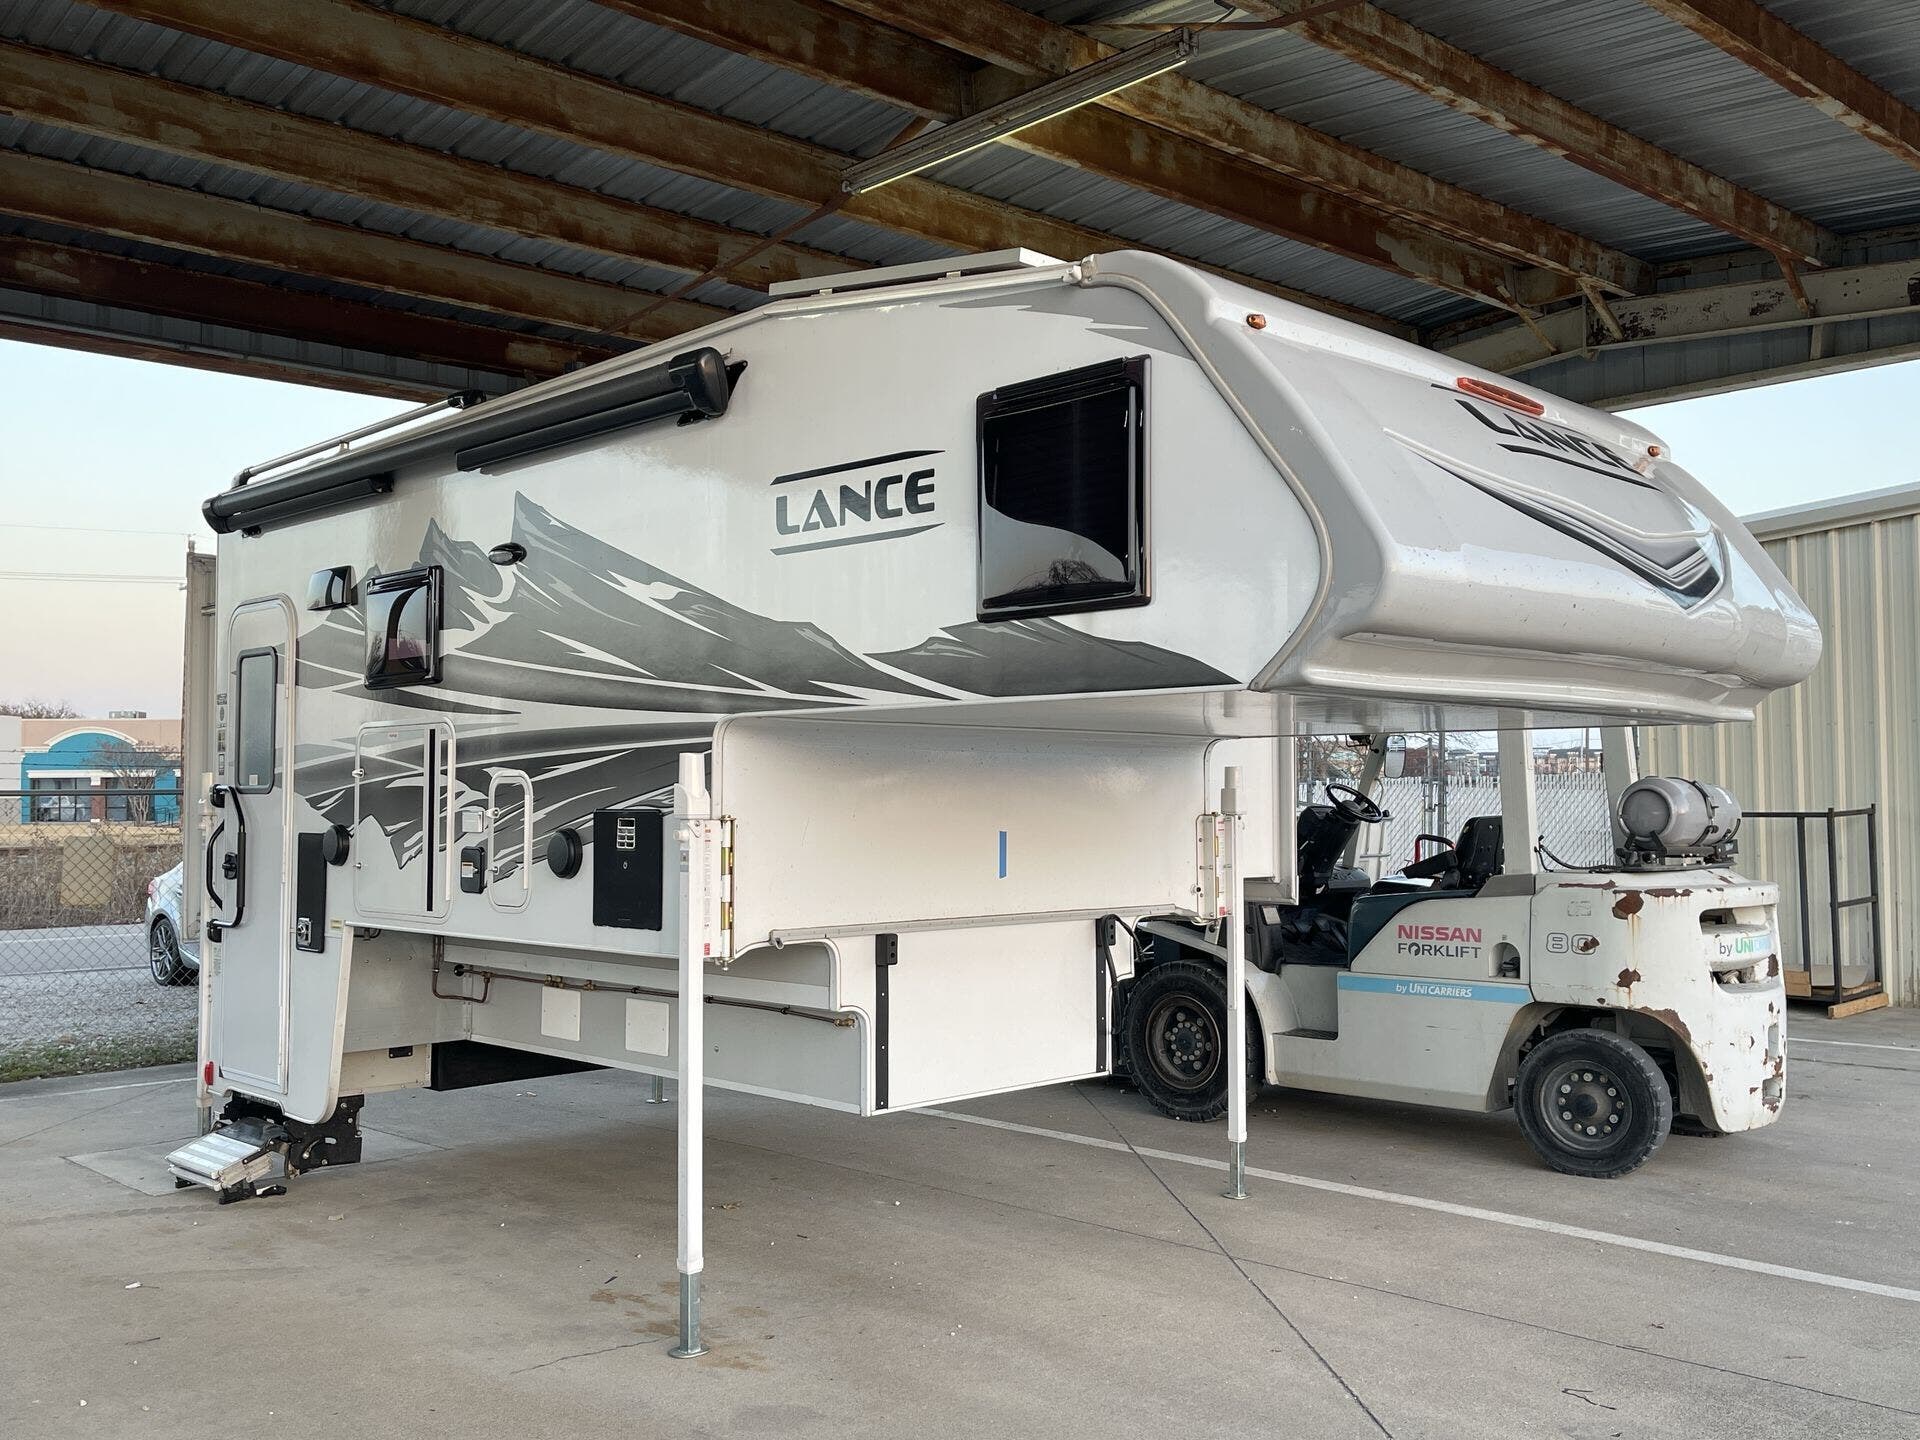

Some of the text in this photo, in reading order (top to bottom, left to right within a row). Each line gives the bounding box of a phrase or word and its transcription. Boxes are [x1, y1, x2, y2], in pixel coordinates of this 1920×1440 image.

[1455, 398, 1644, 476] LANCE
[776, 468, 935, 535] LANCE
[1398, 924, 1482, 942] NISSAN
[1398, 942, 1482, 958] FORKLIFT
[1719, 942, 1733, 957] by
[1396, 982, 1473, 998] by UNICARRIERS
